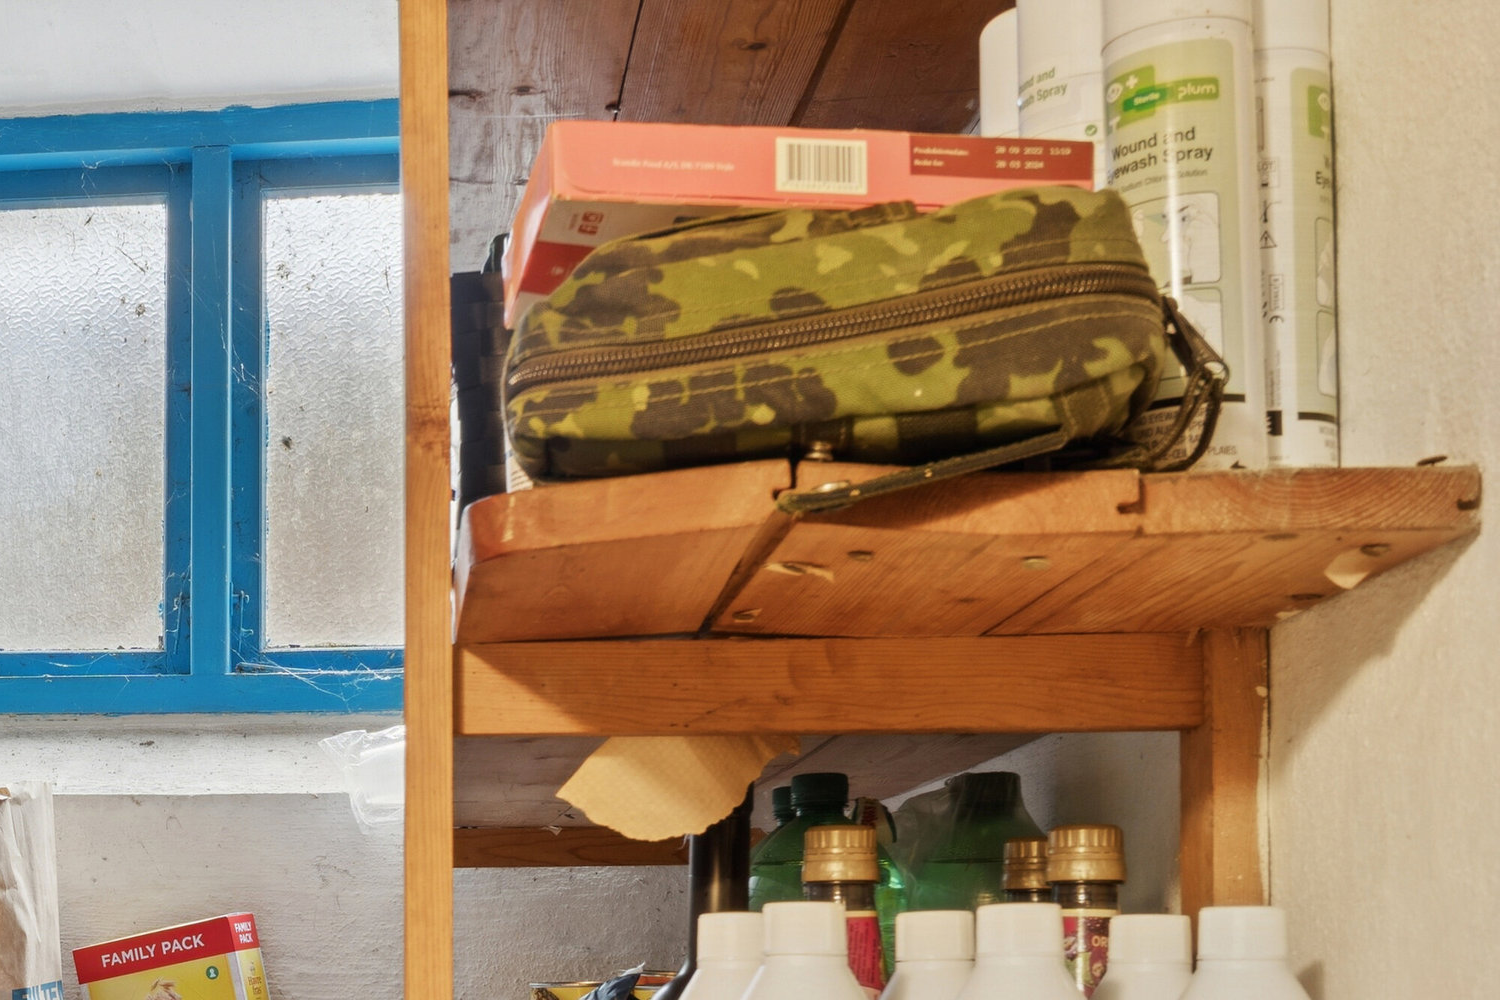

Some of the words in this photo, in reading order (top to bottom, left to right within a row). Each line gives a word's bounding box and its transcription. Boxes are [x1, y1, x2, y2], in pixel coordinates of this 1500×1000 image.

[1177, 83, 1216, 100] plum
[233, 921, 252, 934] FAMILY
[239, 932, 254, 944] PACK
[101, 943, 157, 968] FAMILY
[161, 933, 205, 956] PACK
